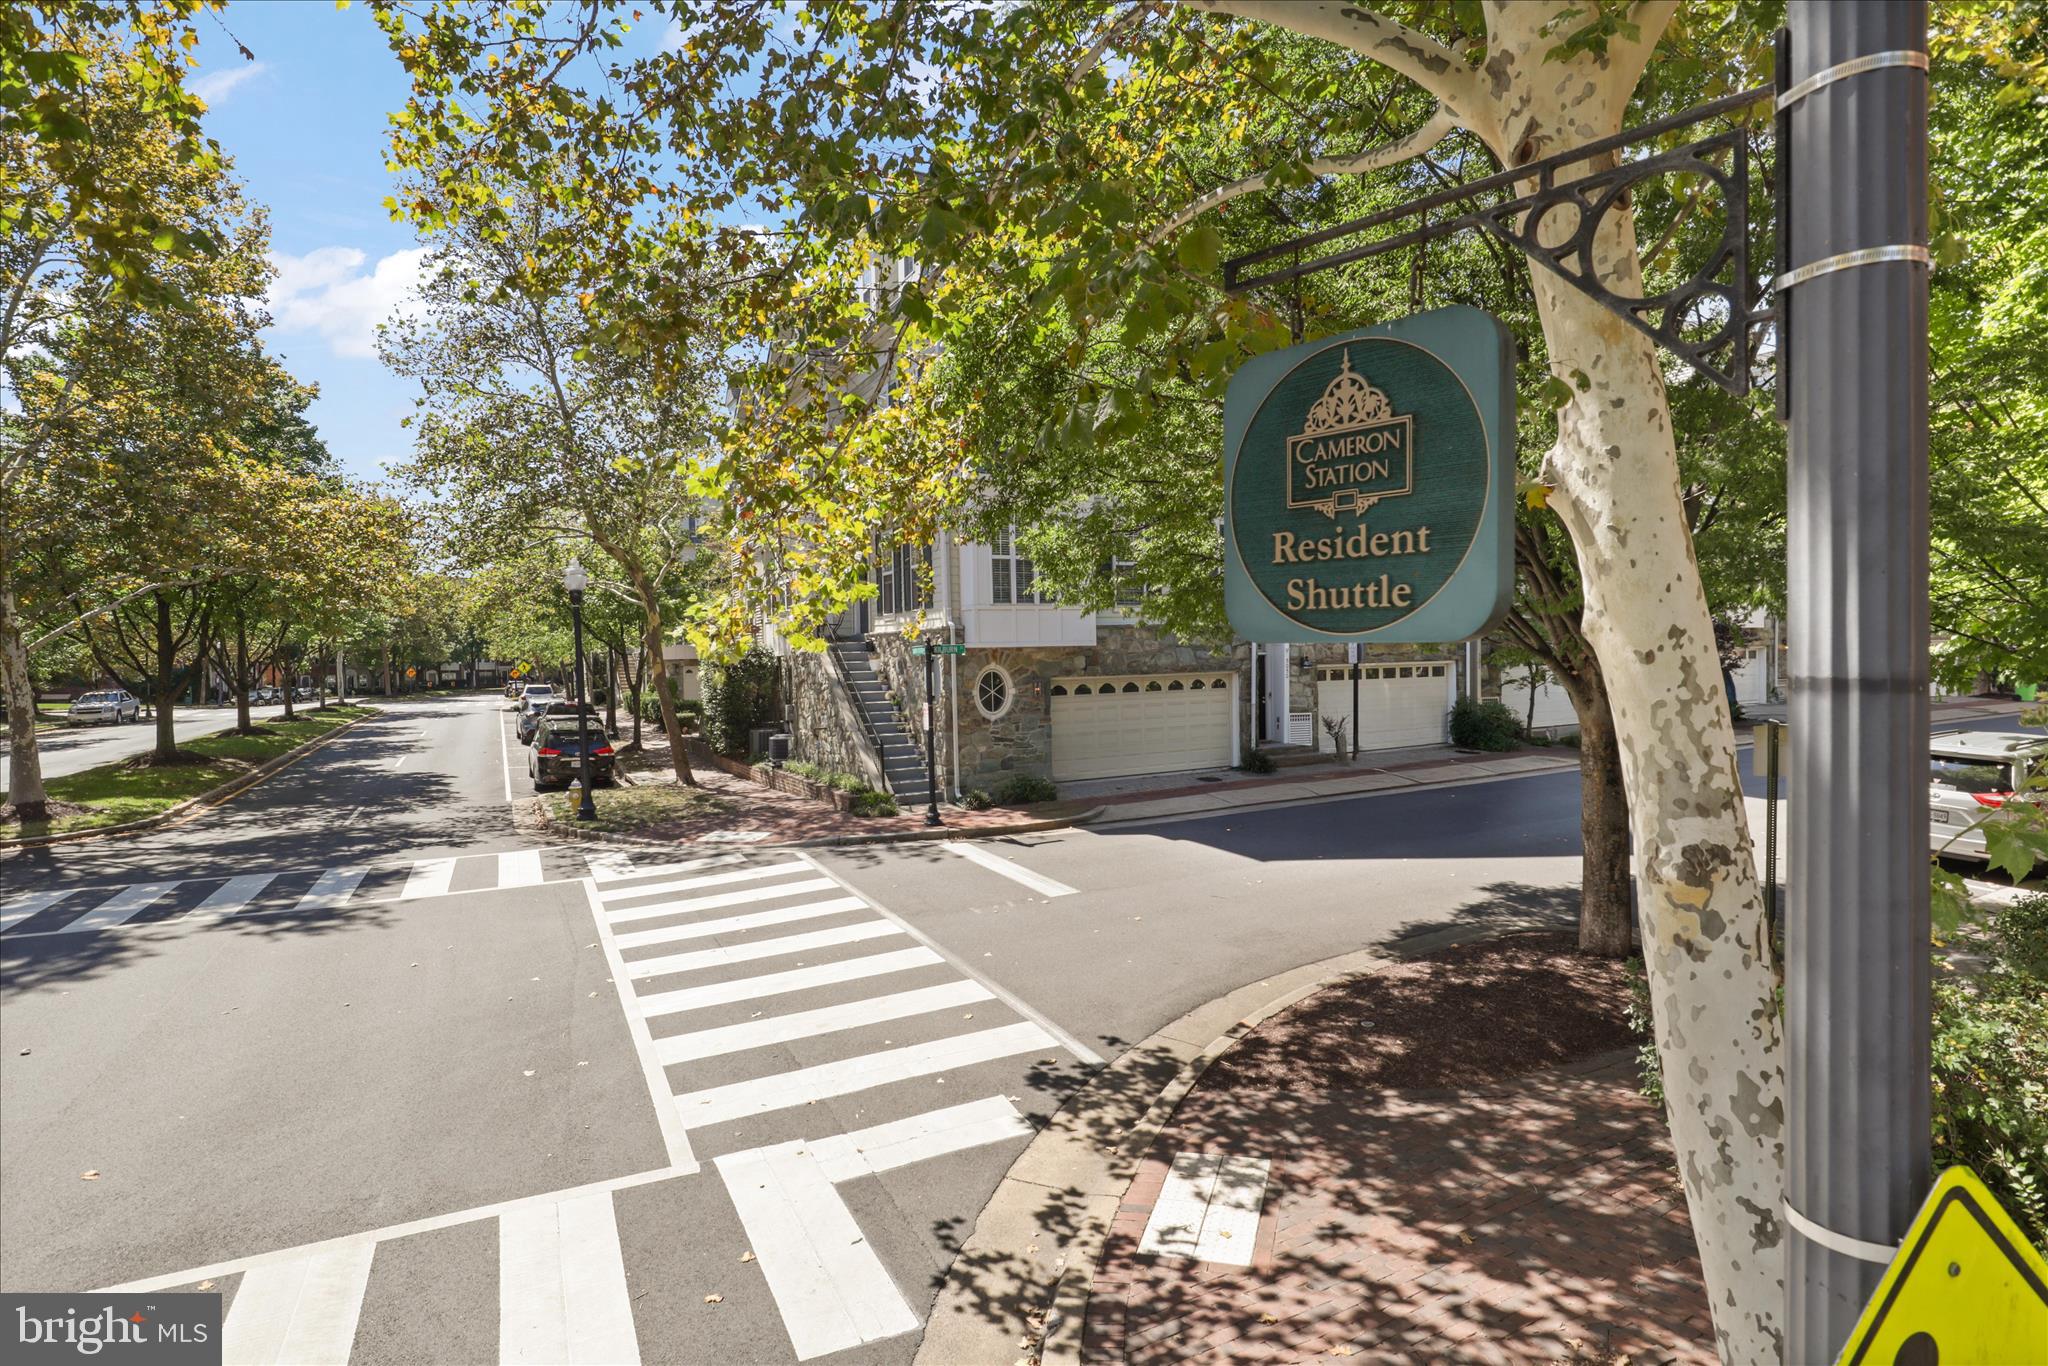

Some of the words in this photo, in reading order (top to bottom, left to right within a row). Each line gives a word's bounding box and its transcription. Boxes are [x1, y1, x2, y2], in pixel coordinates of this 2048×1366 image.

[1296, 428, 1400, 463] CAMERON
[1305, 458, 1388, 489] STATION
[1272, 524, 1431, 564] Resident
[1286, 575, 1411, 611] Shuttle
